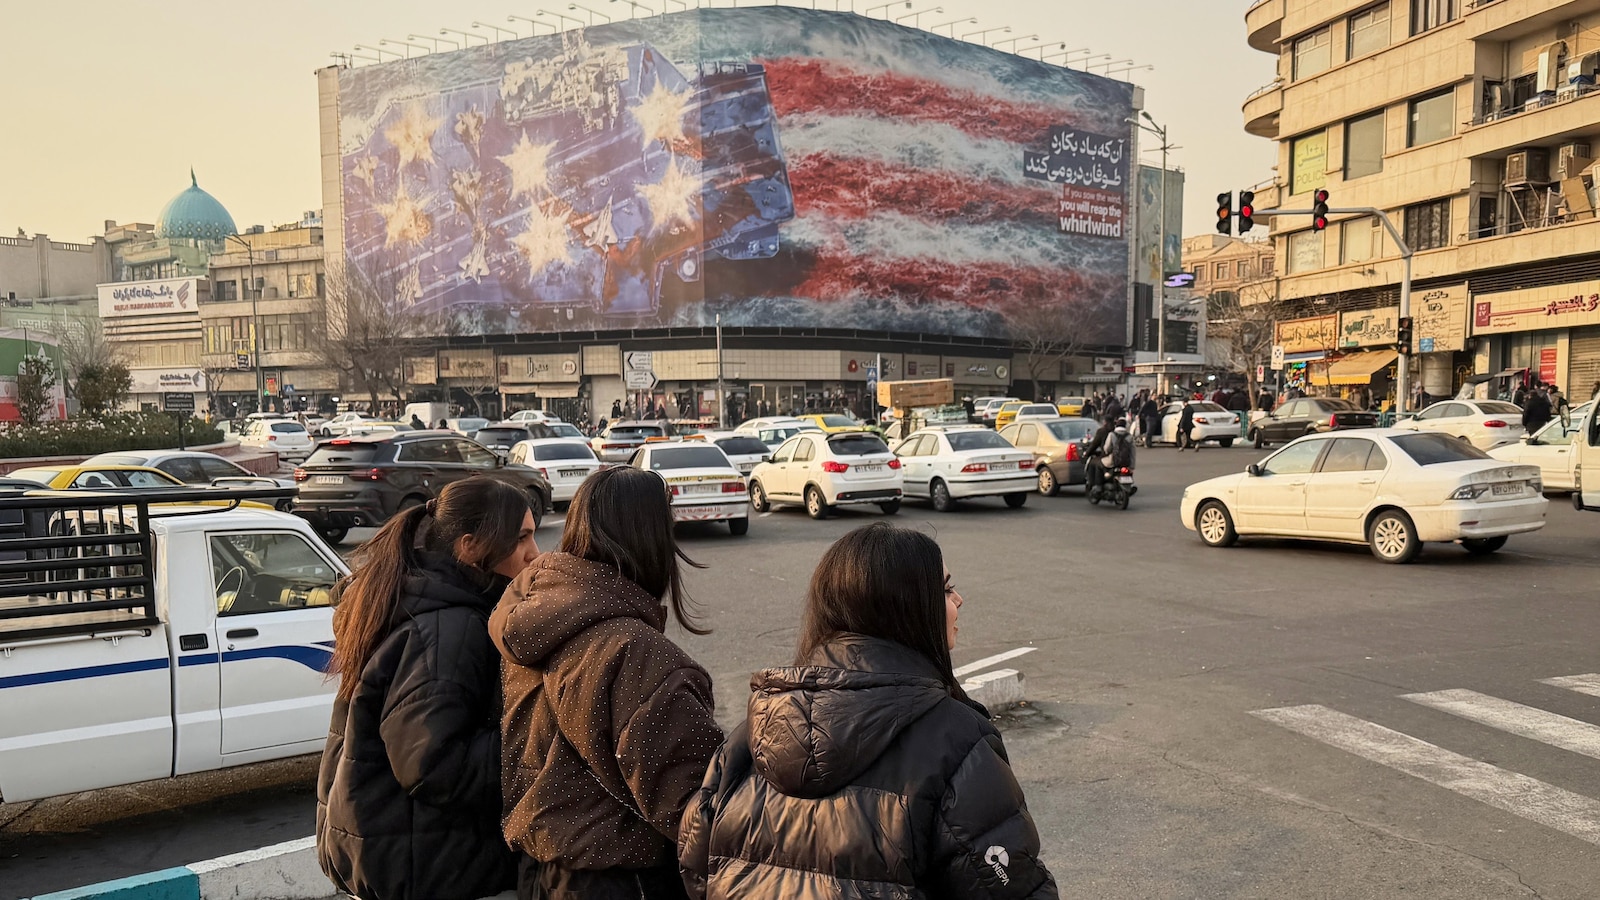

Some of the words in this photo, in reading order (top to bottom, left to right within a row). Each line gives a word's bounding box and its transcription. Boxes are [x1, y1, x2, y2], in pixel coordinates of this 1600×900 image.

[1051, 131, 1078, 157] بکارد
[1080, 136, 1097, 160] باد
[1065, 166, 1083, 184] درو
[1083, 163, 1122, 189] طوفان
[1296, 168, 1326, 187] POLICE
[1065, 187, 1070, 196] If
[1070, 189, 1082, 199] you
[1083, 191, 1095, 200] sow
[1096, 192, 1106, 201] the
[1060, 201, 1075, 213] you
[1076, 202, 1090, 213] will
[1090, 204, 1108, 218] reap
[1109, 206, 1122, 218] the
[1060, 213, 1121, 237] whirlwind
